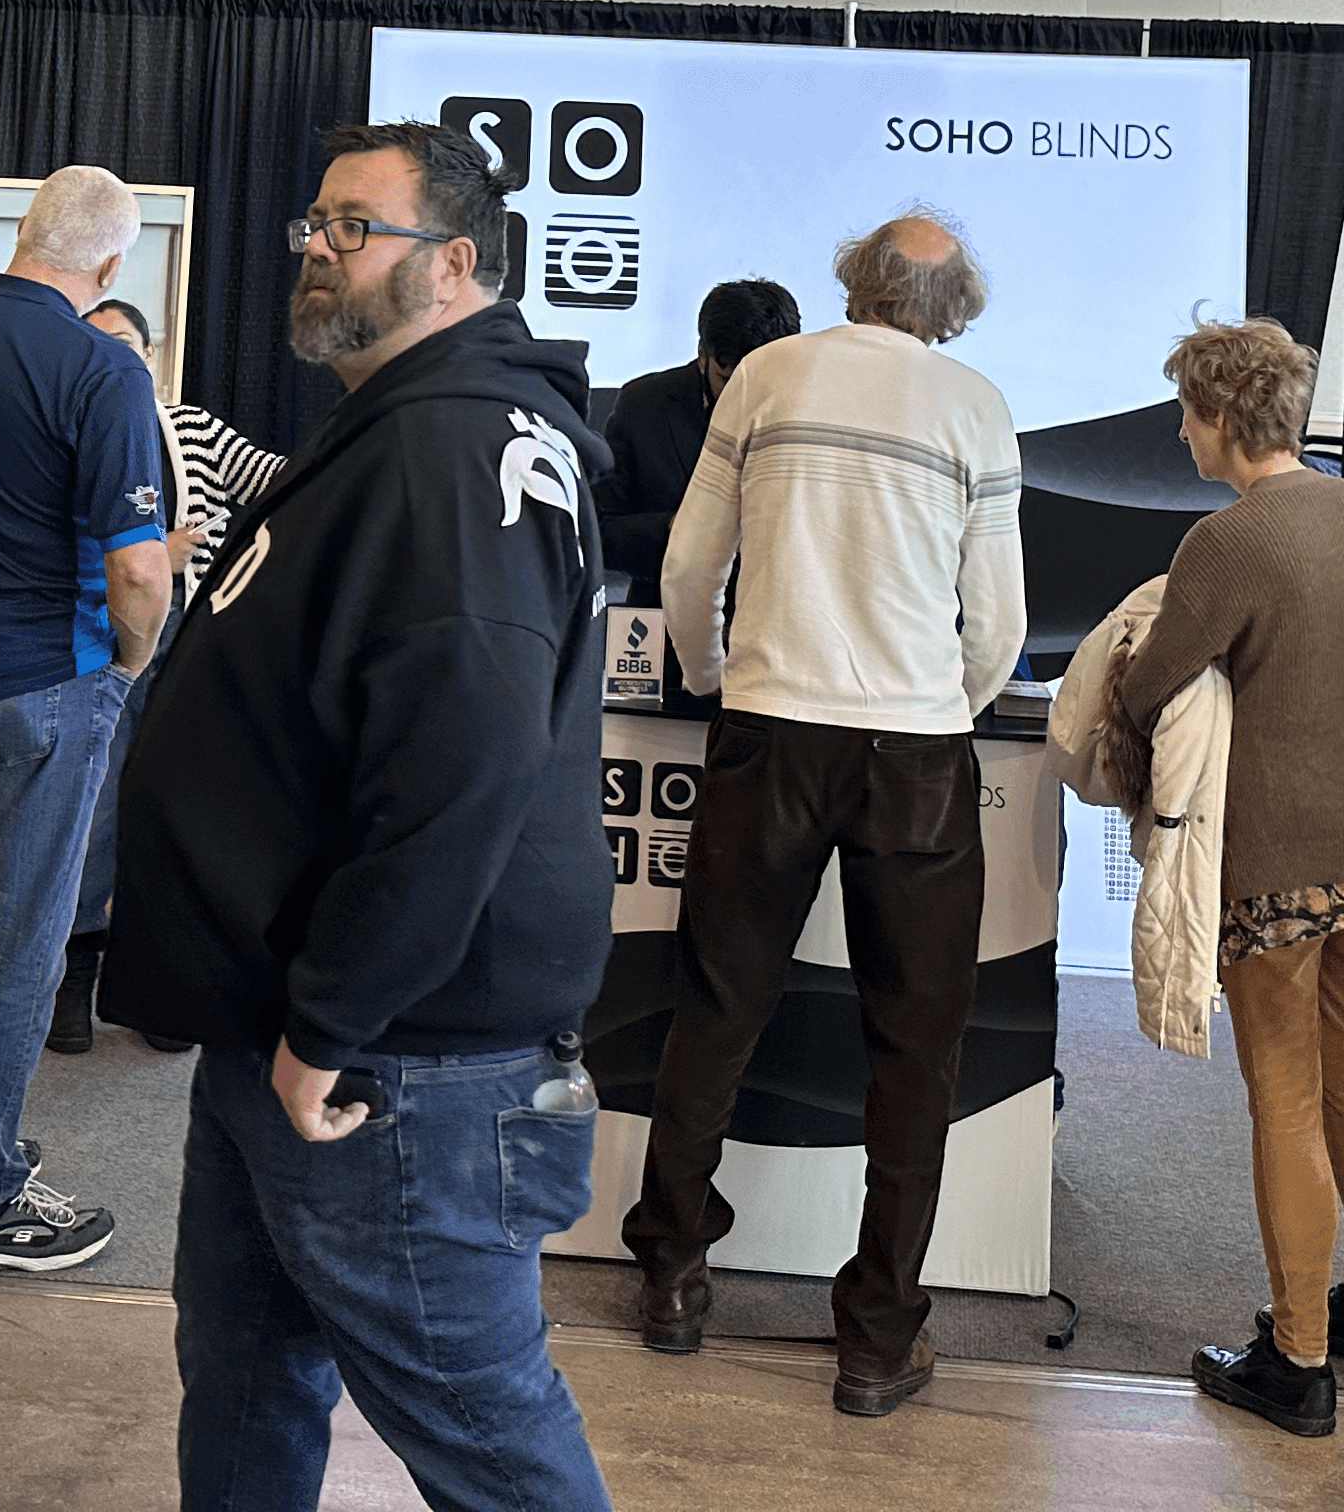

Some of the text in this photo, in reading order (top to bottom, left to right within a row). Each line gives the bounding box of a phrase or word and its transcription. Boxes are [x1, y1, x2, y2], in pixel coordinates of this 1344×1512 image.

[885, 117, 1172, 160] SOHO BLINDS
[617, 659, 651, 673] BBB
